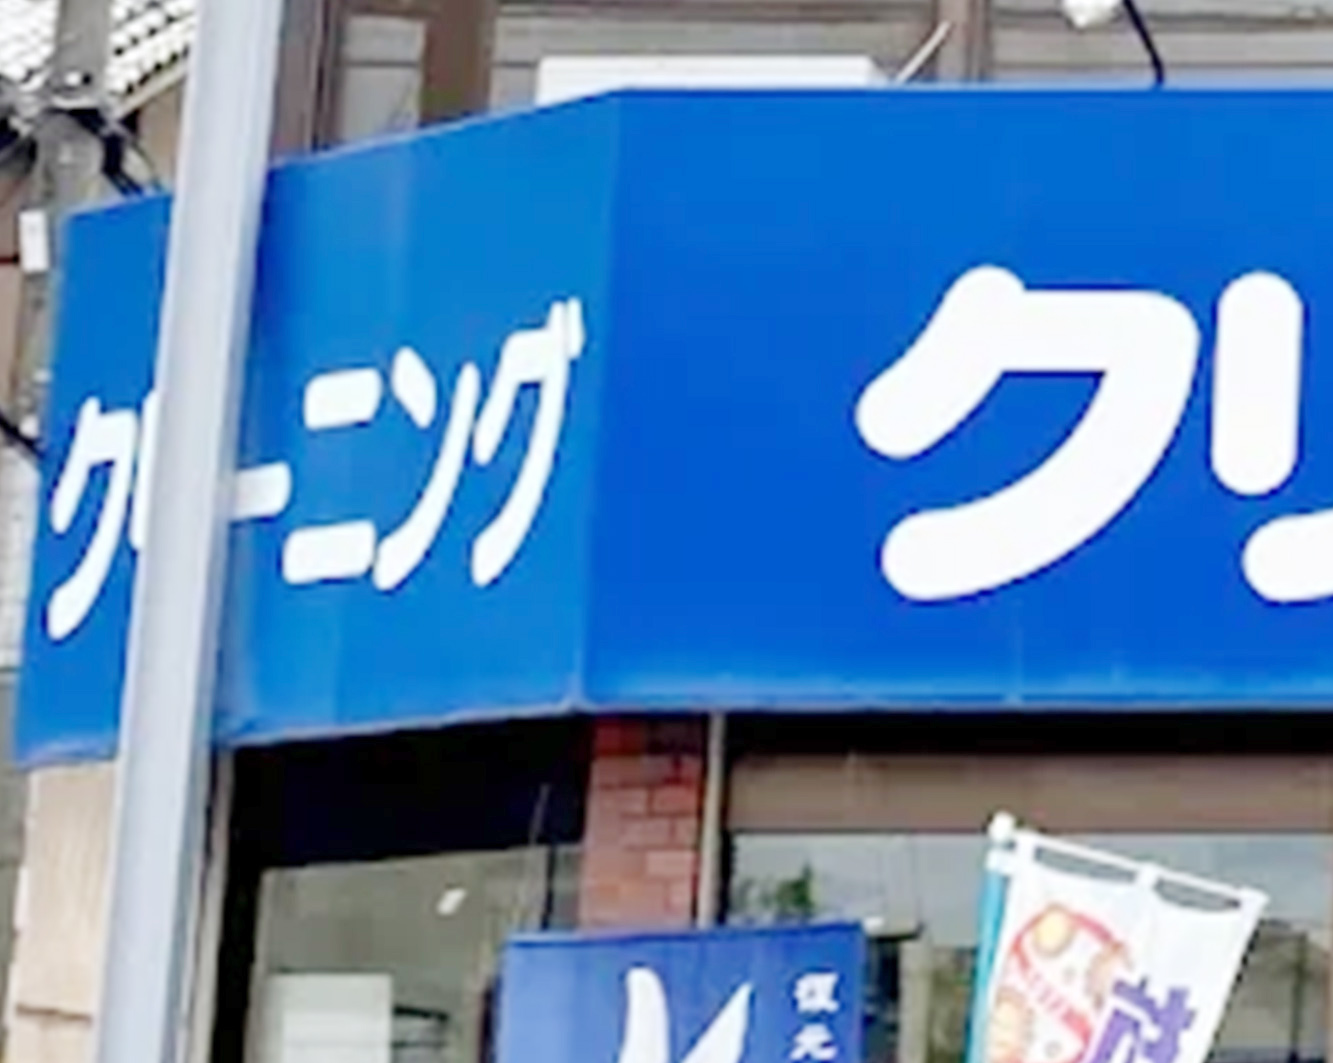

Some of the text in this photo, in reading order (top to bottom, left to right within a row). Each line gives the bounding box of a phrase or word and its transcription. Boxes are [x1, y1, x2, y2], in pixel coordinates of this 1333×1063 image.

[46, 297, 585, 640] クーニング
